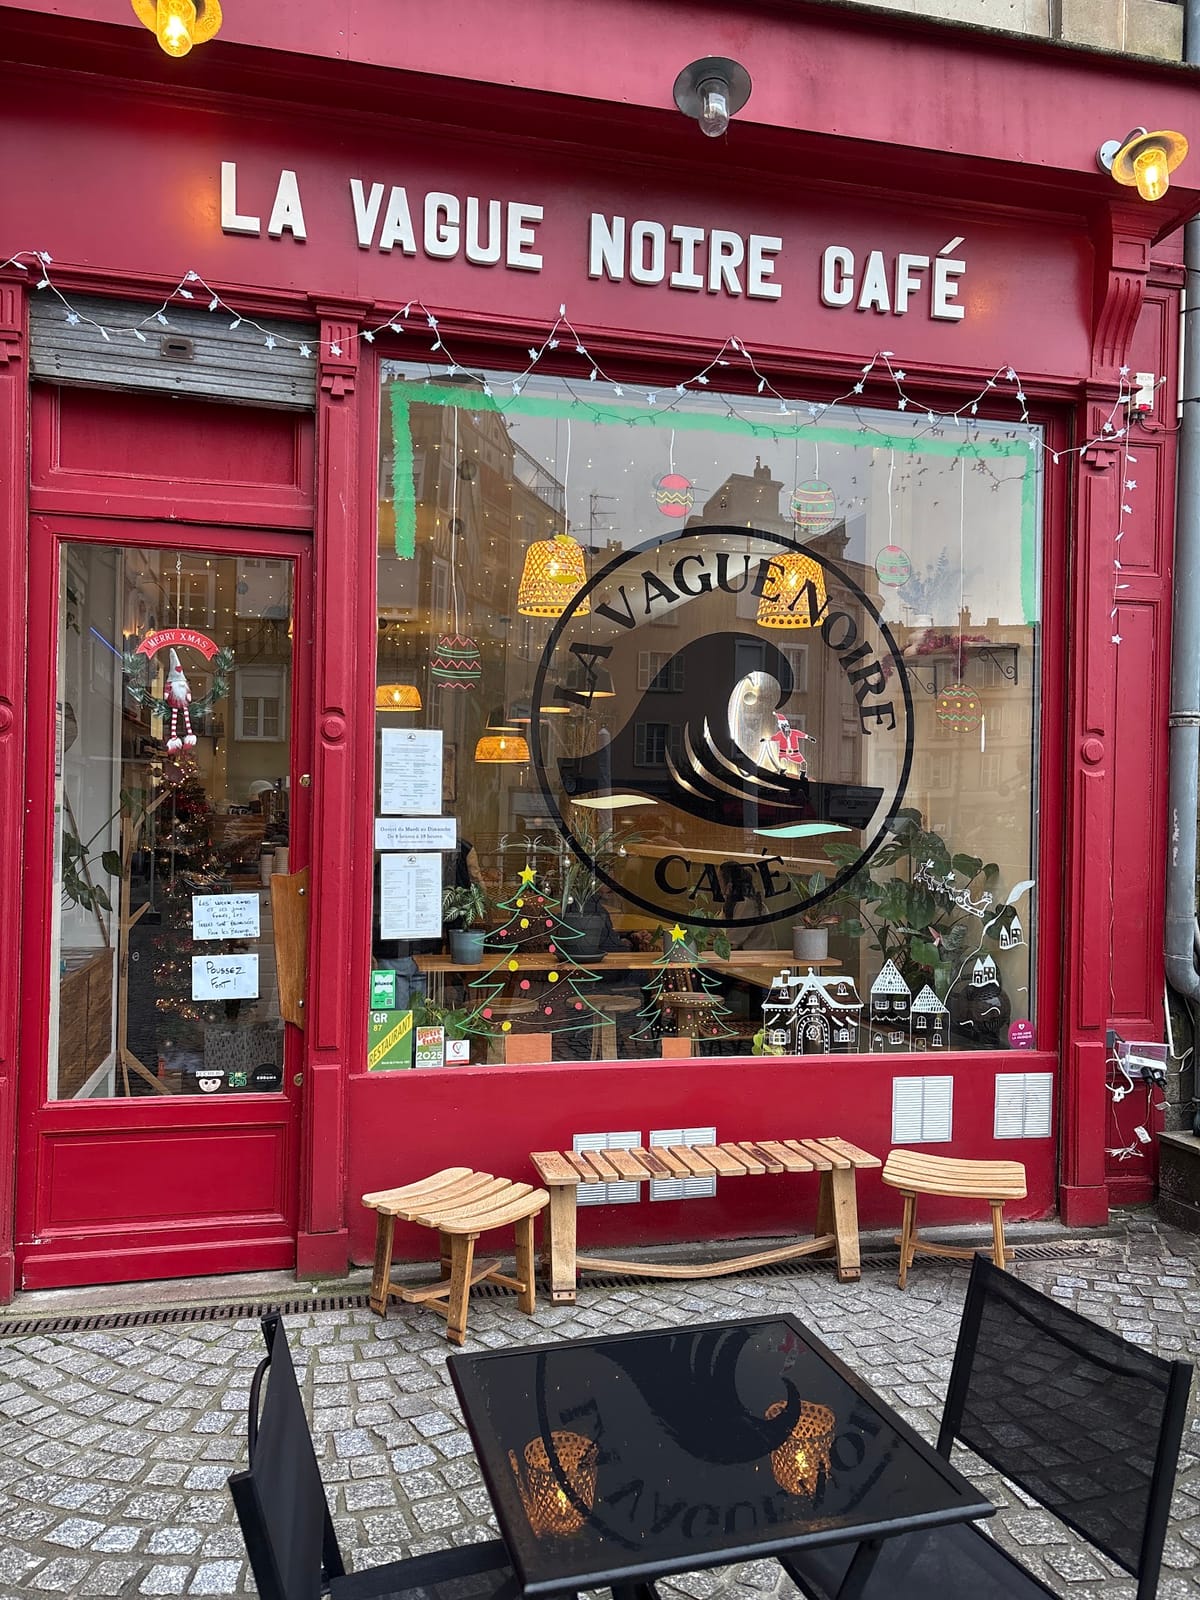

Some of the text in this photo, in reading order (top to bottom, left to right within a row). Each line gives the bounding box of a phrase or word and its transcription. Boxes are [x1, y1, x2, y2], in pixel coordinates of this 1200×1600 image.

[220, 160, 966, 322] LA VAGUE NOIRE CAFÉ
[147, 632, 208, 649] MERRY XMAS
[552, 553, 897, 737] LA VAGUE NOIRE
[654, 847, 792, 903] CAFÉ
[206, 960, 246, 975] POUSSEZ
[373, 1013, 388, 1023] GR
[373, 1024, 382, 1032] 87
[369, 1016, 411, 1065] RESTAURANT
[417, 1051, 443, 1060] 2025
